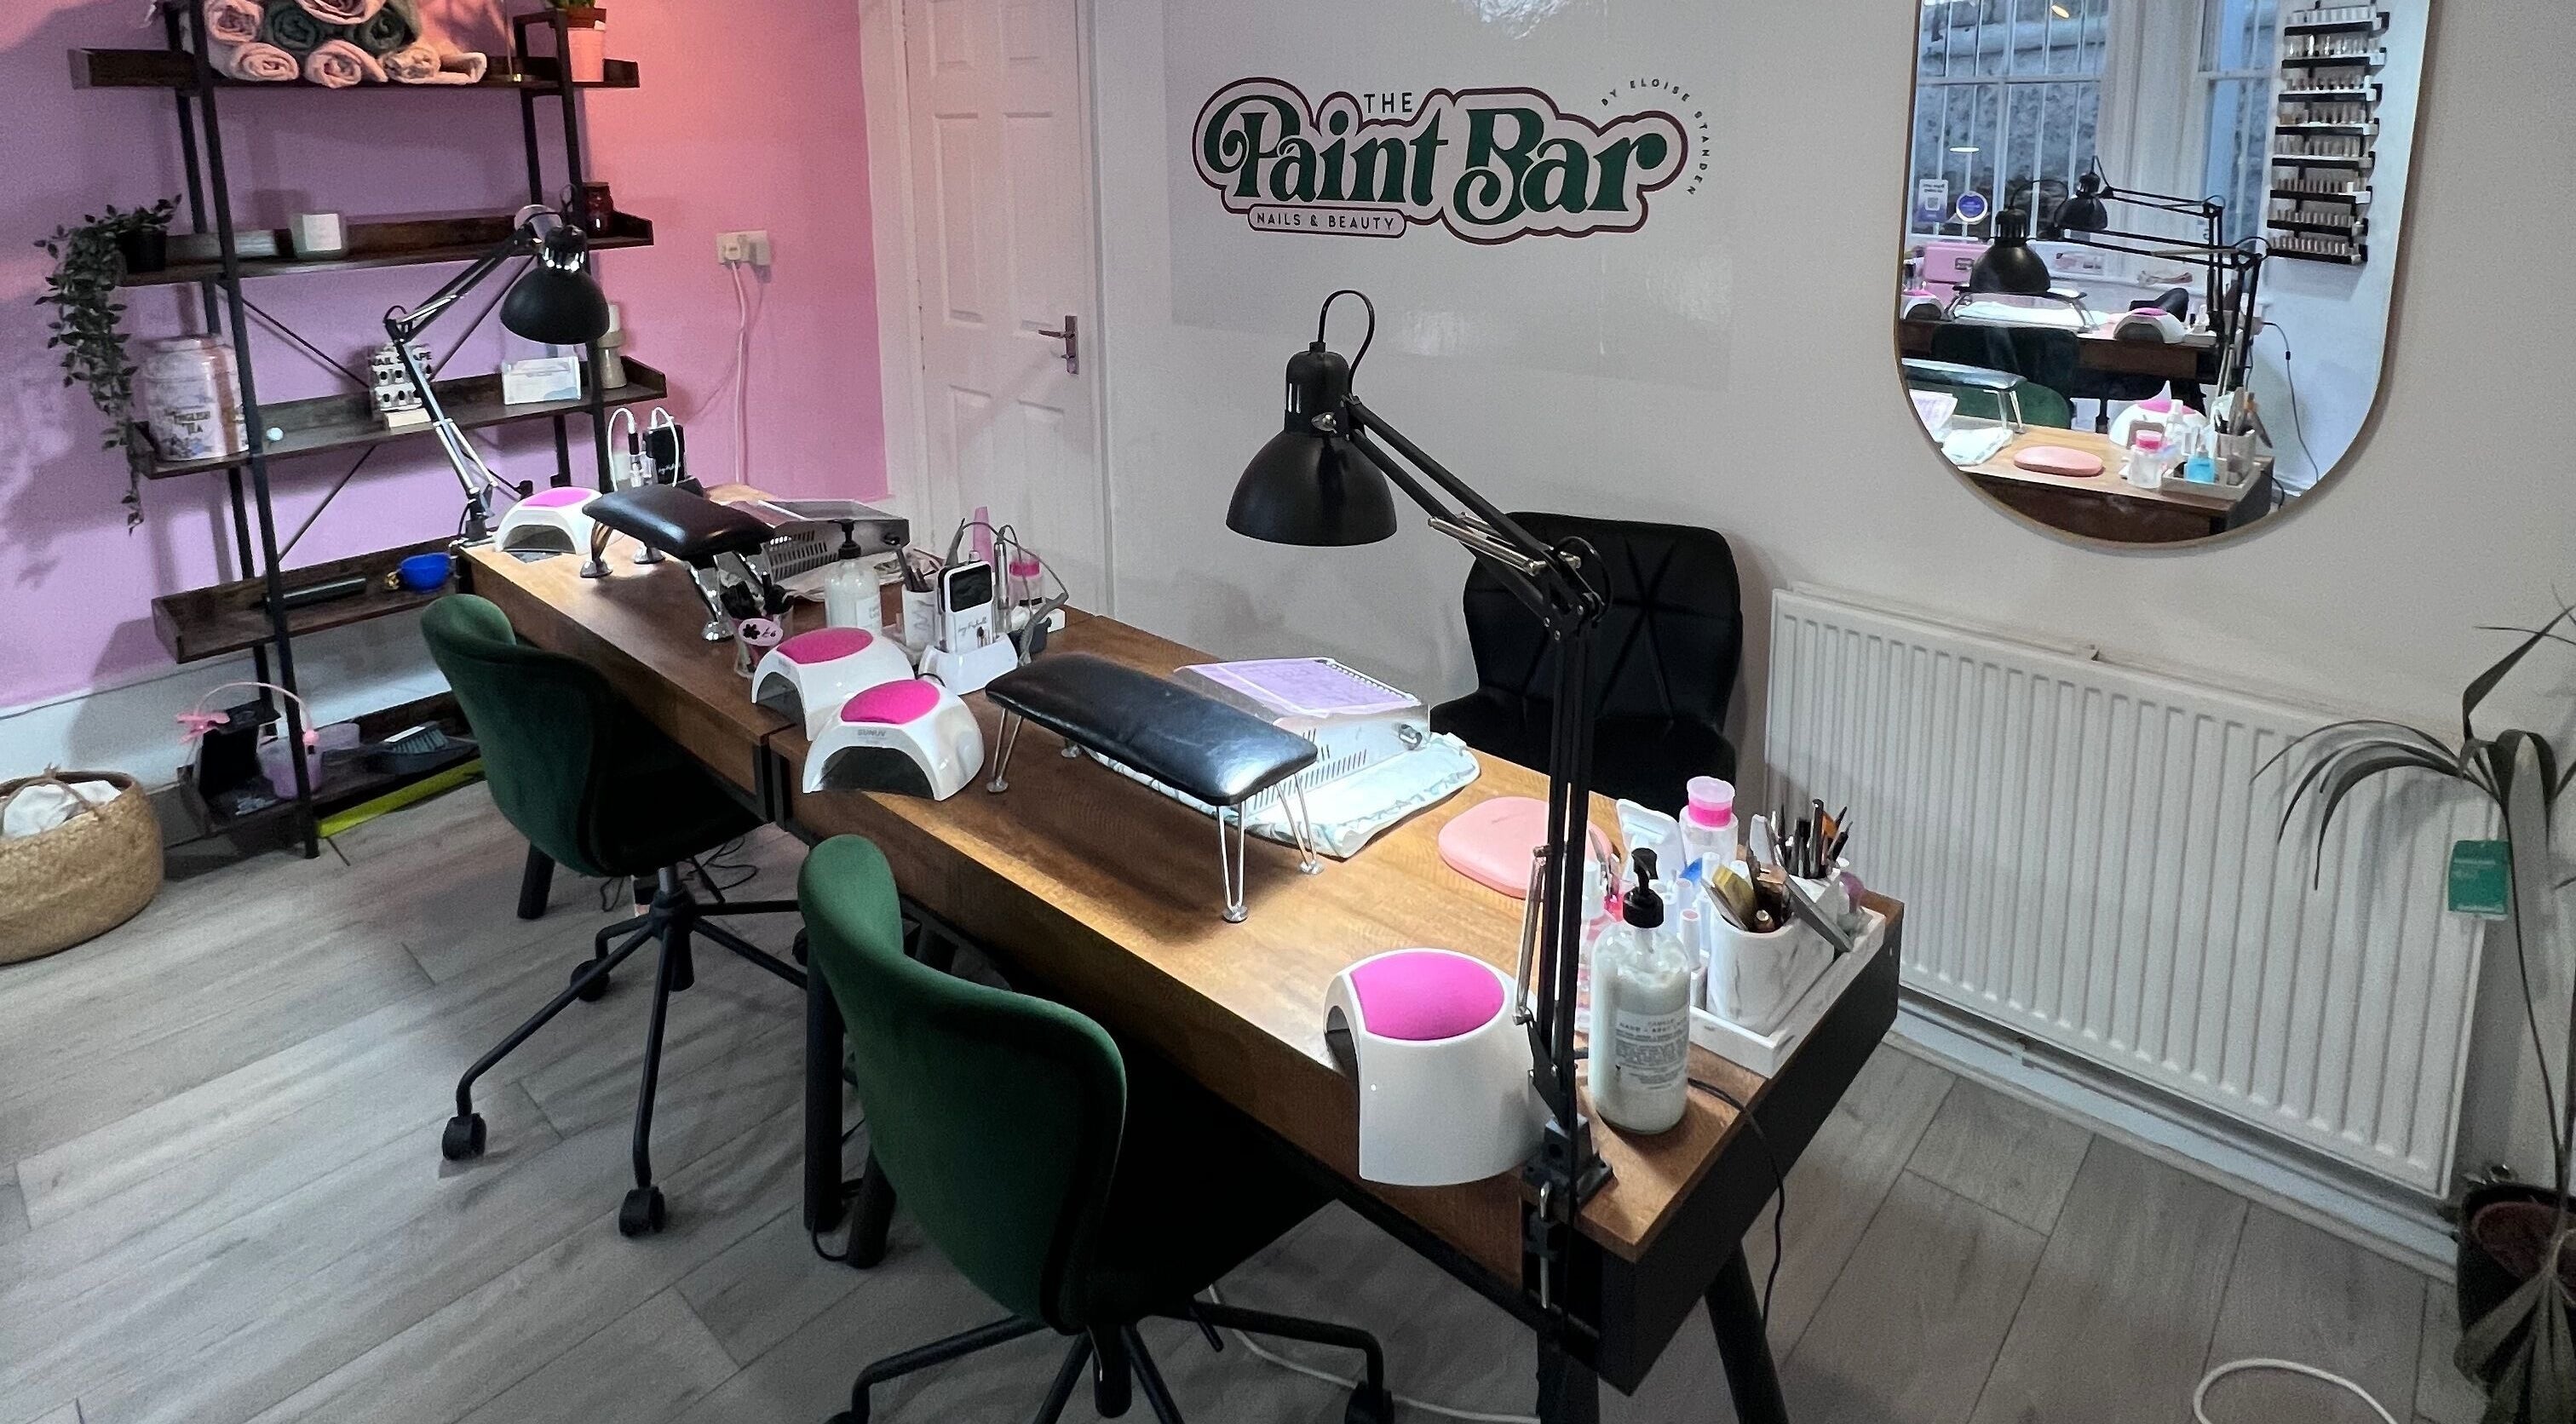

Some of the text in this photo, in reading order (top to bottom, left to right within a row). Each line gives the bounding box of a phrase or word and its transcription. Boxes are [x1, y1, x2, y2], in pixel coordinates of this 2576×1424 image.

[1363, 92, 1413, 114] THE
[1601, 78, 1710, 195] BY ELOISE STANDEN
[1203, 95, 1667, 226] Paint Bar
[1256, 212, 1394, 231] NAILS & BEAUTY
